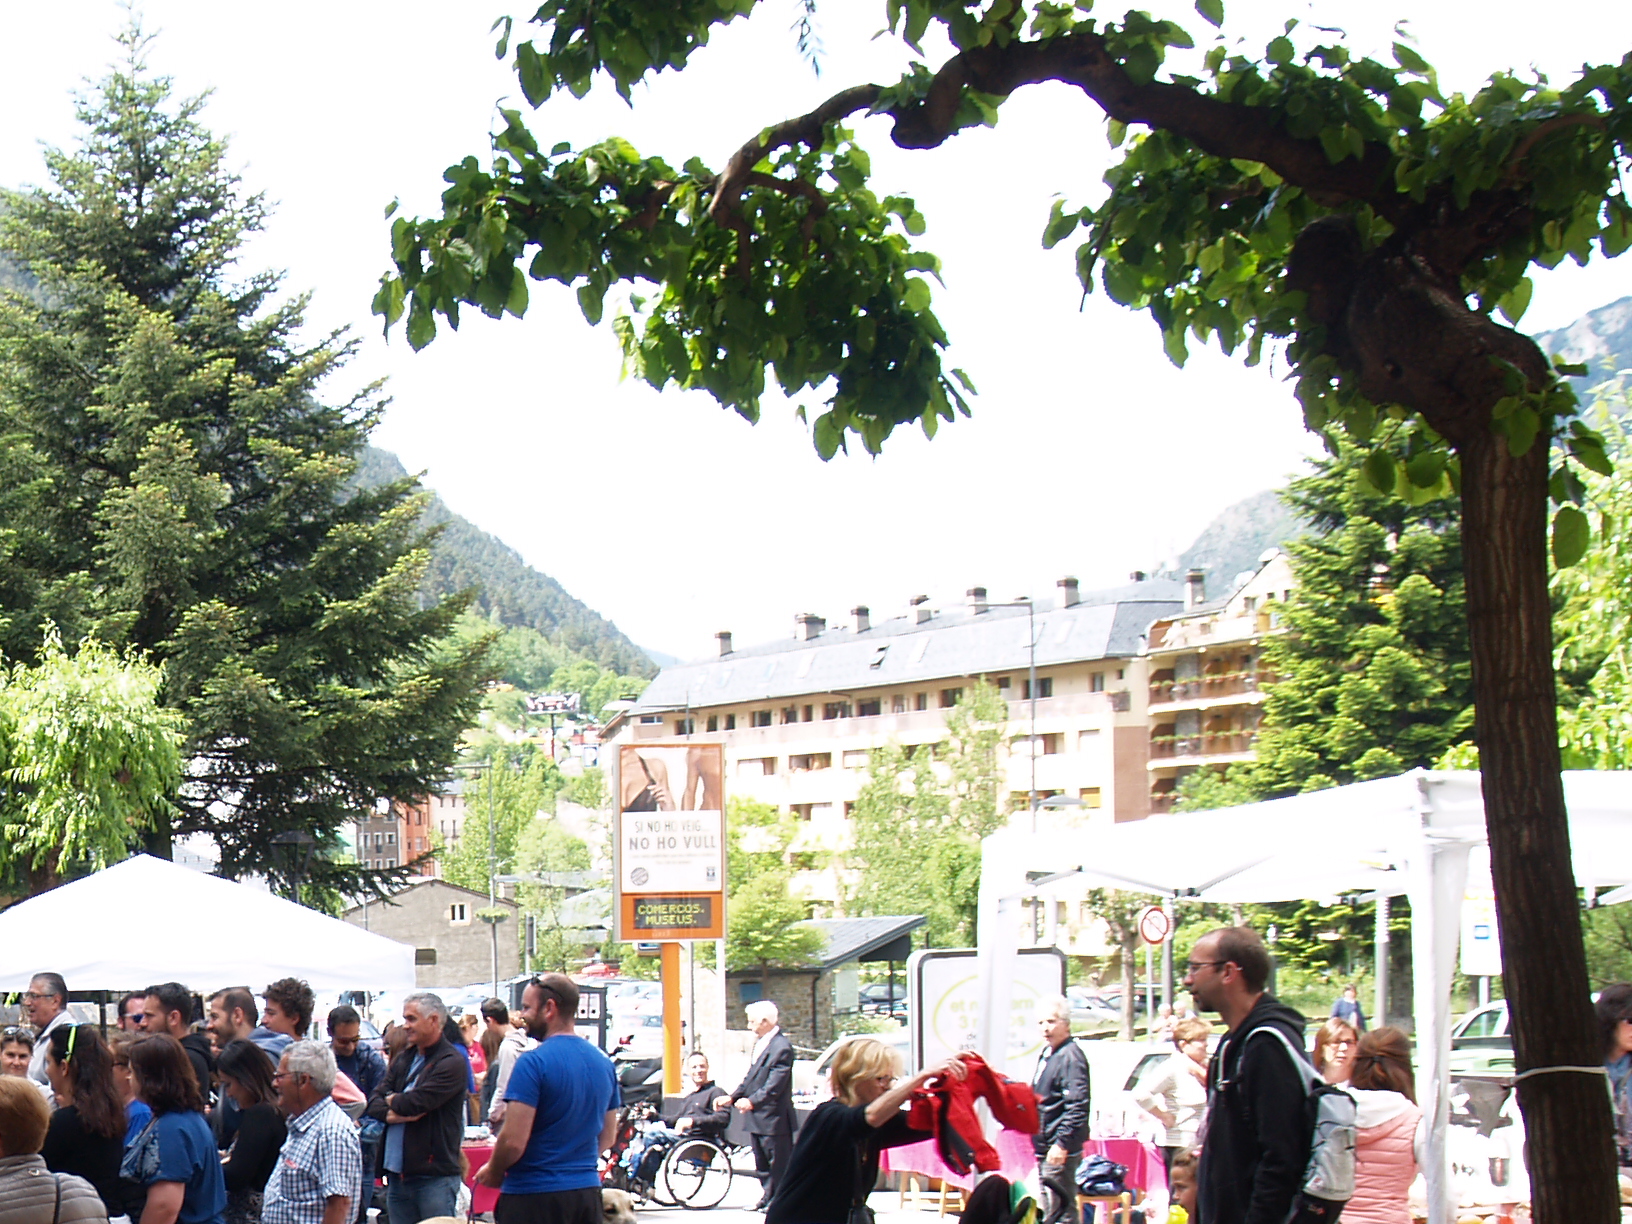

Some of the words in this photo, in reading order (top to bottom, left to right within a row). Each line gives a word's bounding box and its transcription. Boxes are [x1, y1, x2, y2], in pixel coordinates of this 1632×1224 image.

[634, 820, 644, 834] SI
[647, 820, 661, 833] NO
[629, 837, 650, 850] NO
[657, 836, 677, 849] HO
[683, 835, 717, 849] VULL
